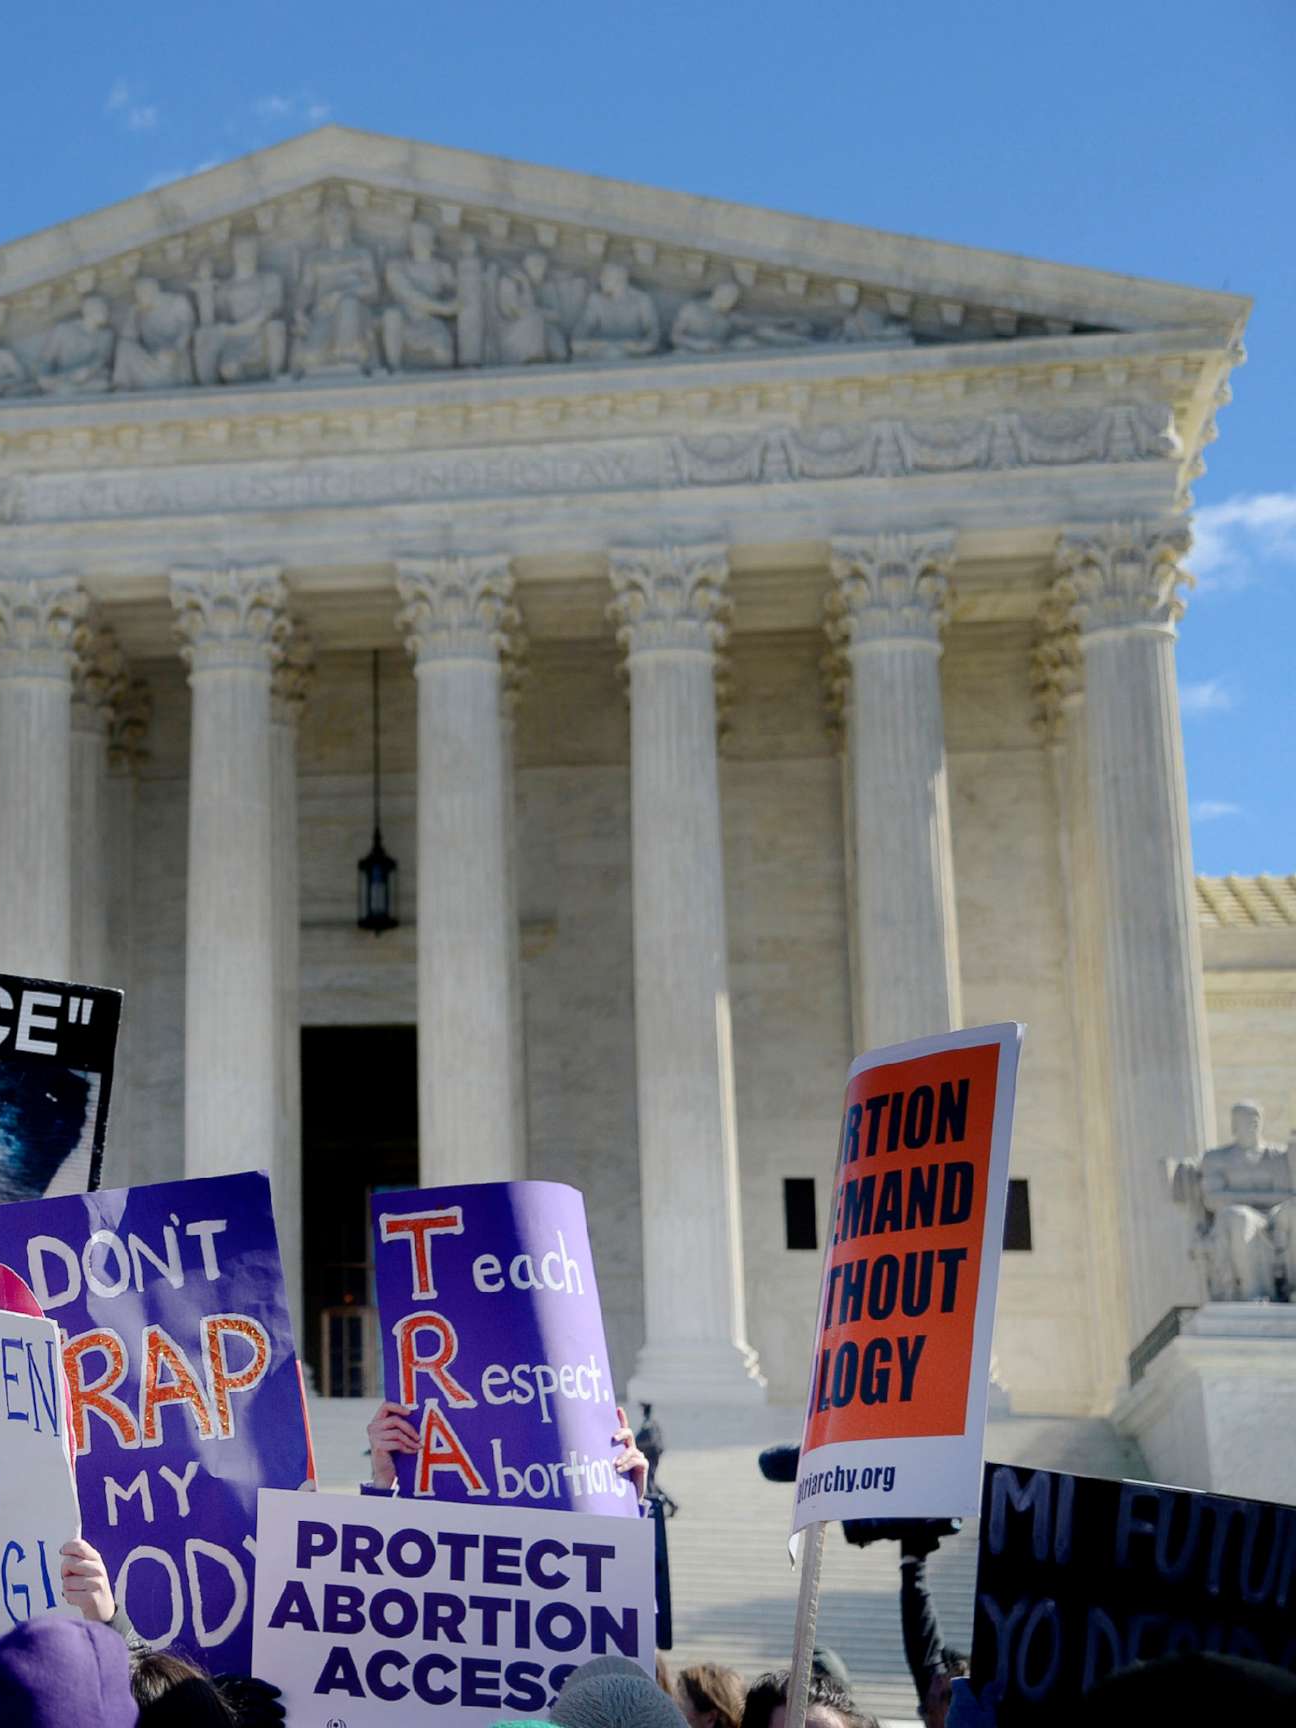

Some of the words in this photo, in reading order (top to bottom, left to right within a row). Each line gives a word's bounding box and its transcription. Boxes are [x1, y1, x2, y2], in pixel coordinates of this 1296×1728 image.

[843, 1079, 970, 1164] RTION
[28, 1213, 226, 1309] DON'T
[379, 1206, 584, 1300] Teach
[63, 1314, 270, 1455] RAP
[809, 1335, 927, 1418] LOGY
[104, 1461, 200, 1526] MY
[990, 1466, 1076, 1566] MI
[114, 1534, 256, 1651] OD
[297, 1520, 614, 1593] PROTECT
[268, 1580, 638, 1658] ABORTION
